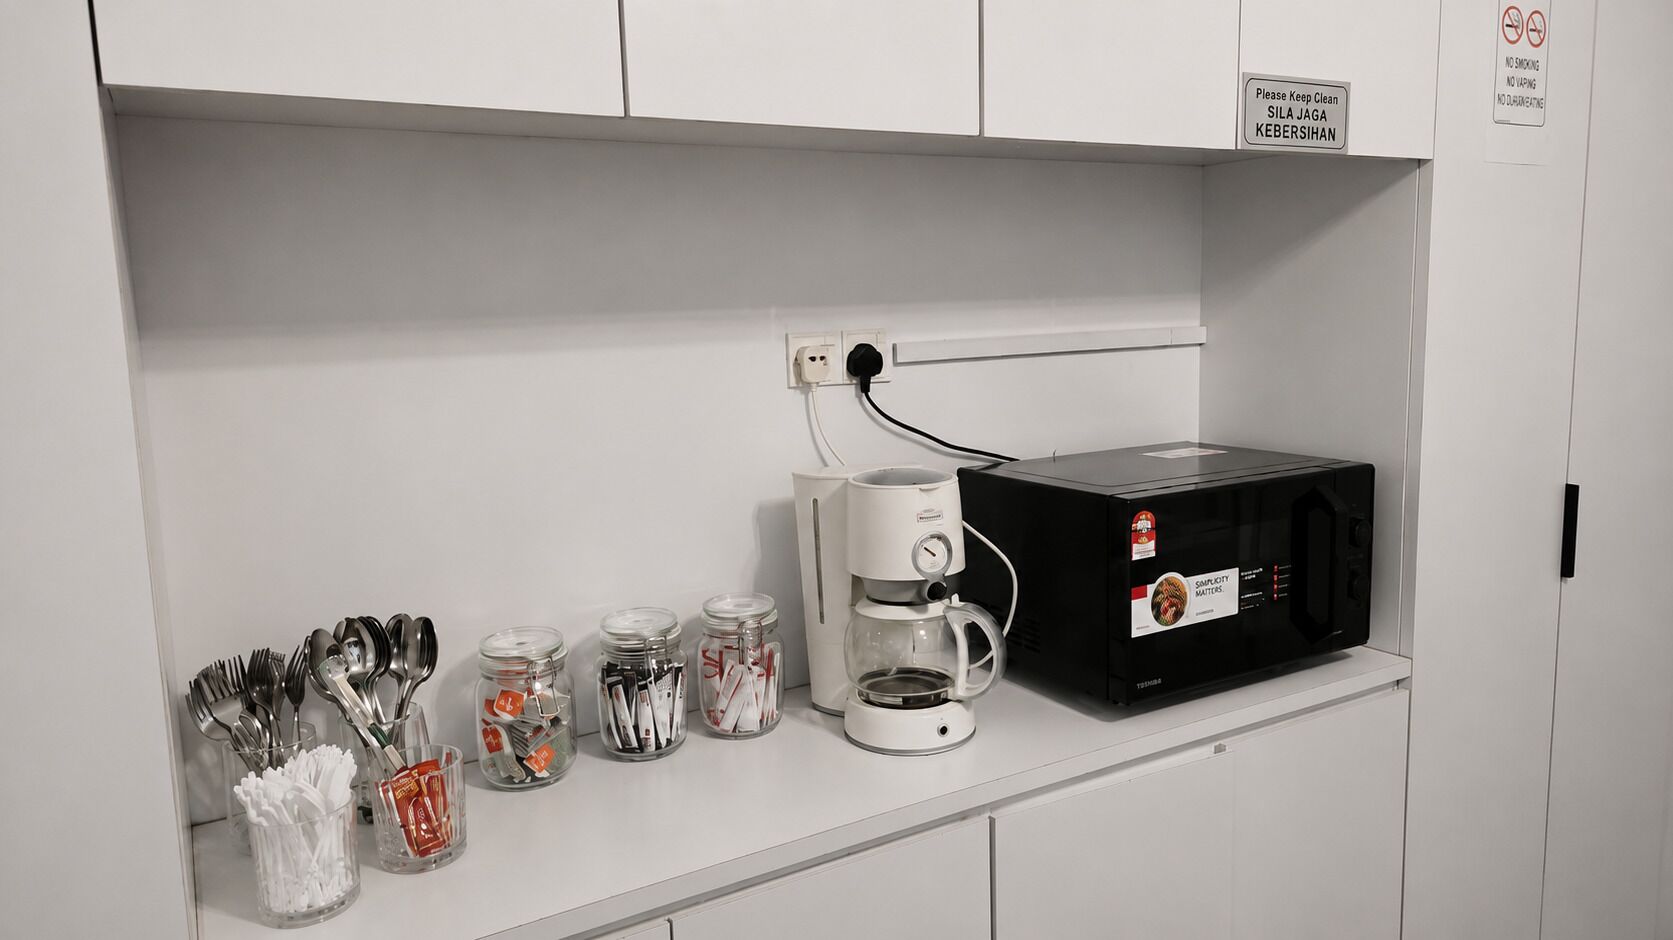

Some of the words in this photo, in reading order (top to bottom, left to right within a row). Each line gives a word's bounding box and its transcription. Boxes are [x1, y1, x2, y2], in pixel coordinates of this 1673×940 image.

[1505, 56, 1514, 68] NO
[1506, 76, 1515, 87] NO
[1256, 87, 1287, 101] Please
[1289, 90, 1312, 105] Keep
[1314, 92, 1338, 105] Clean
[1267, 105, 1294, 120] SILA
[1296, 108, 1327, 122] JAGA
[1256, 122, 1336, 141] KEBERSIHAN
[1195, 575, 1229, 589] SIMPLICITY
